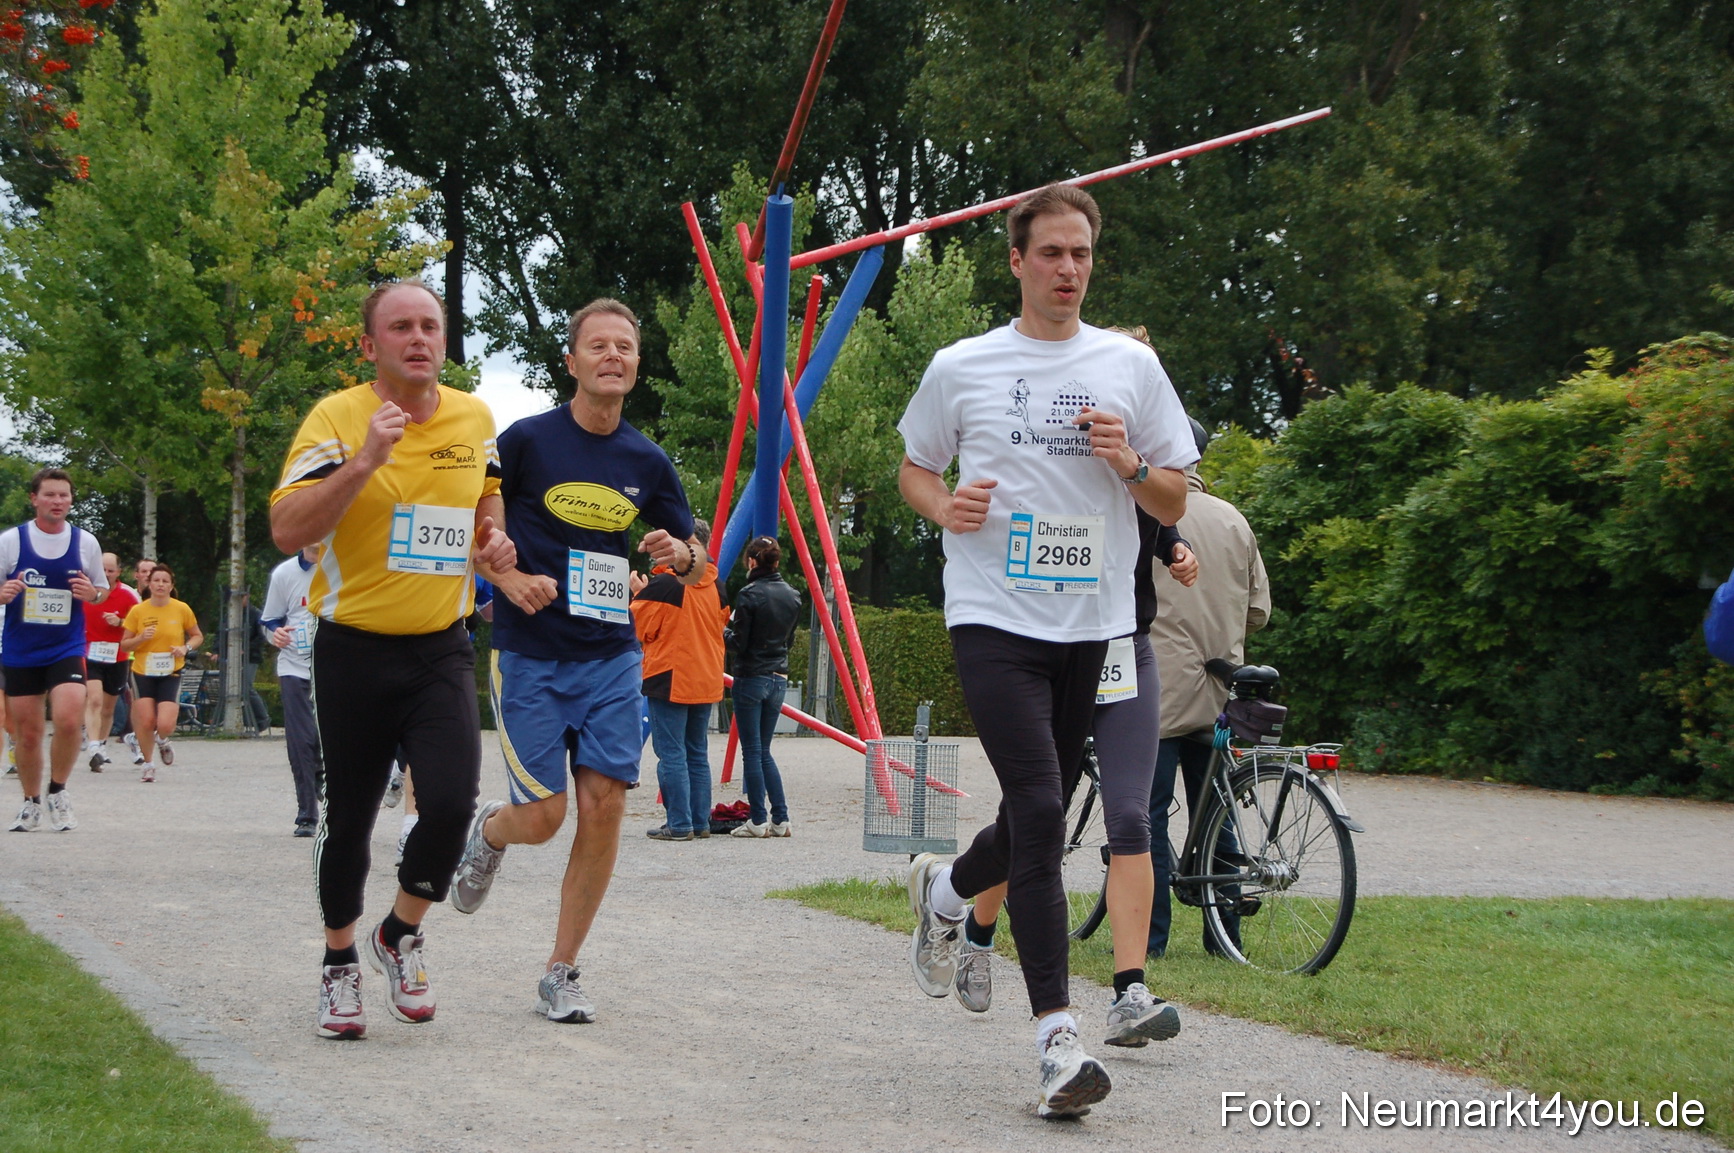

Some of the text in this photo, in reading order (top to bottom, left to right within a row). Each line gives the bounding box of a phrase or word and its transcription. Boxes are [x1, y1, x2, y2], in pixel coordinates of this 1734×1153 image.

[1051, 408, 1083, 416] 21.09.2
[1011, 431, 1091, 446] 9. Neumarkte
[1047, 446, 1095, 457] Stadtlau
[552, 493, 601, 511] trimm
[609, 504, 639, 517] fit
[418, 525, 466, 547] 3703
[1037, 521, 1089, 538] Christian
[1014, 541, 1021, 551] B
[1036, 545, 1092, 566] 2968
[588, 558, 616, 573] Günter
[587, 578, 624, 600] 3298
[1064, 582, 1098, 590] PFLEIDERER
[42, 602, 64, 613] 362
[156, 661, 171, 669] 555
[1100, 664, 1122, 682] 35
